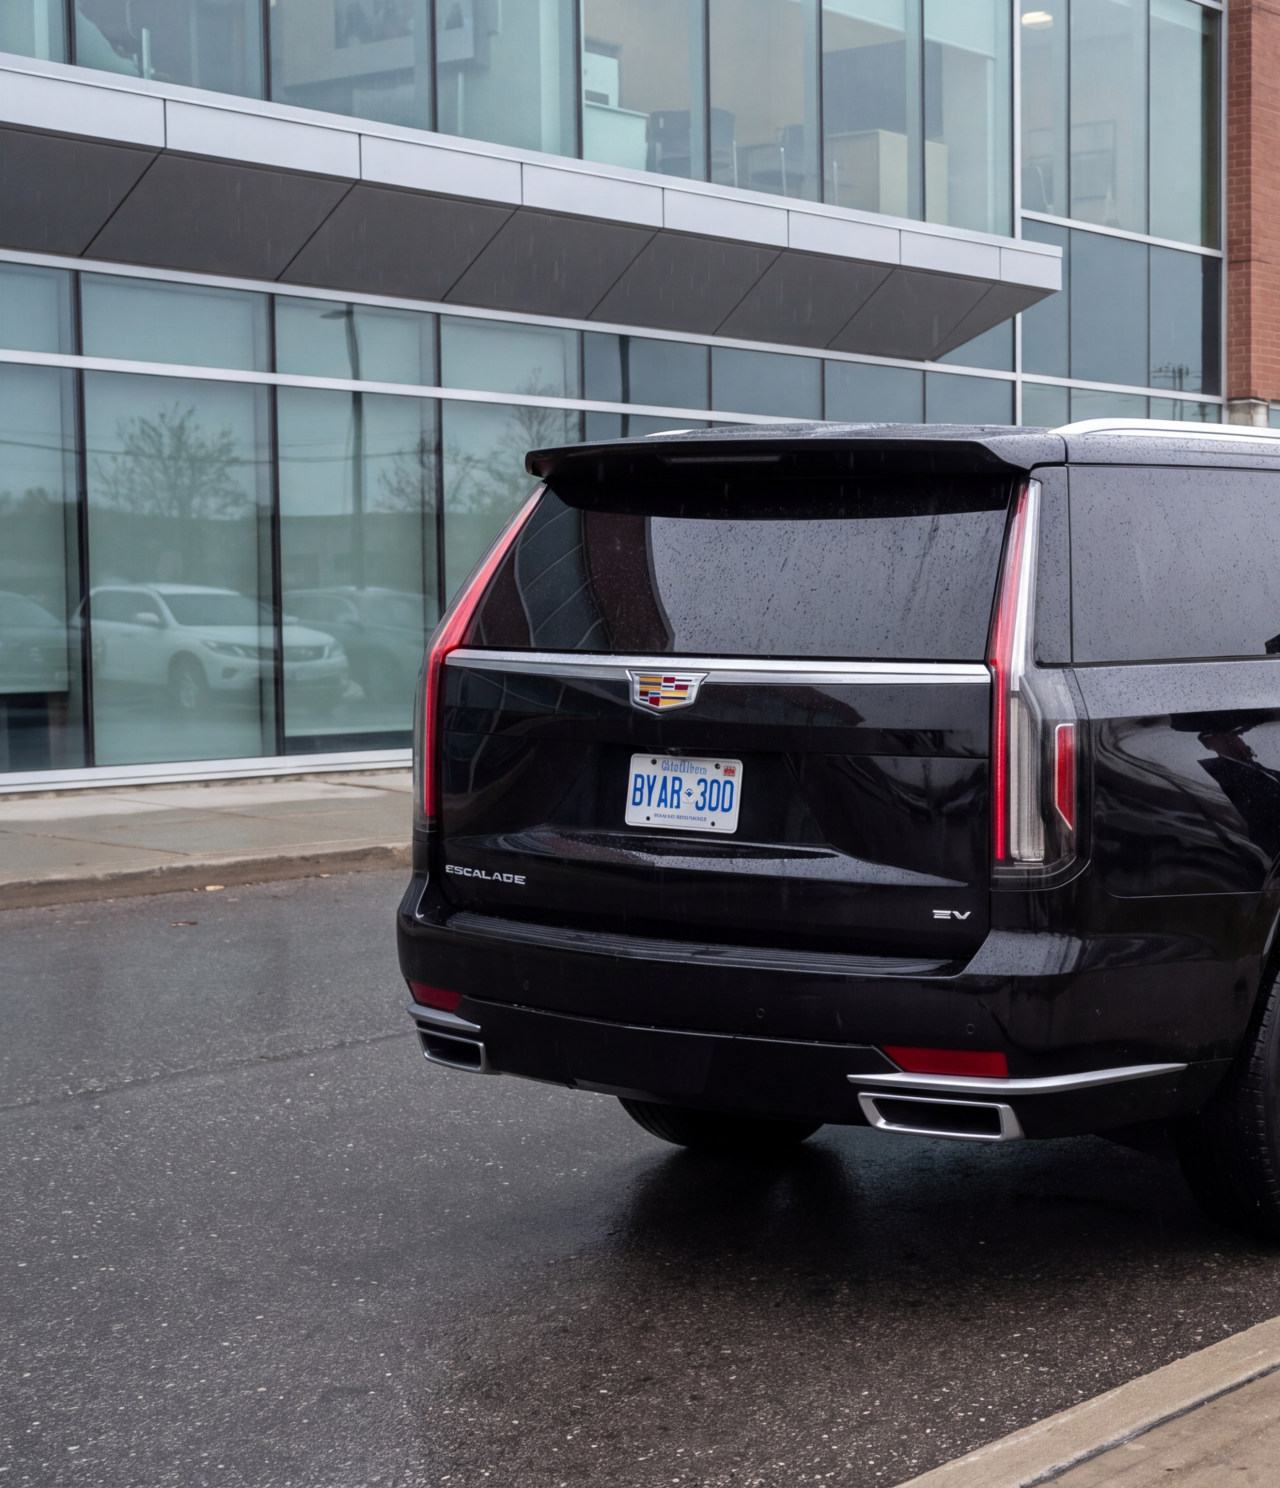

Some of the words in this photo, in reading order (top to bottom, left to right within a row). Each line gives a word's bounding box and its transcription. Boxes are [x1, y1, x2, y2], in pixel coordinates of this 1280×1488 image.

[632, 773, 682, 809] BYAR
[445, 864, 526, 885] ESCALADE
[932, 909, 971, 920] EV
